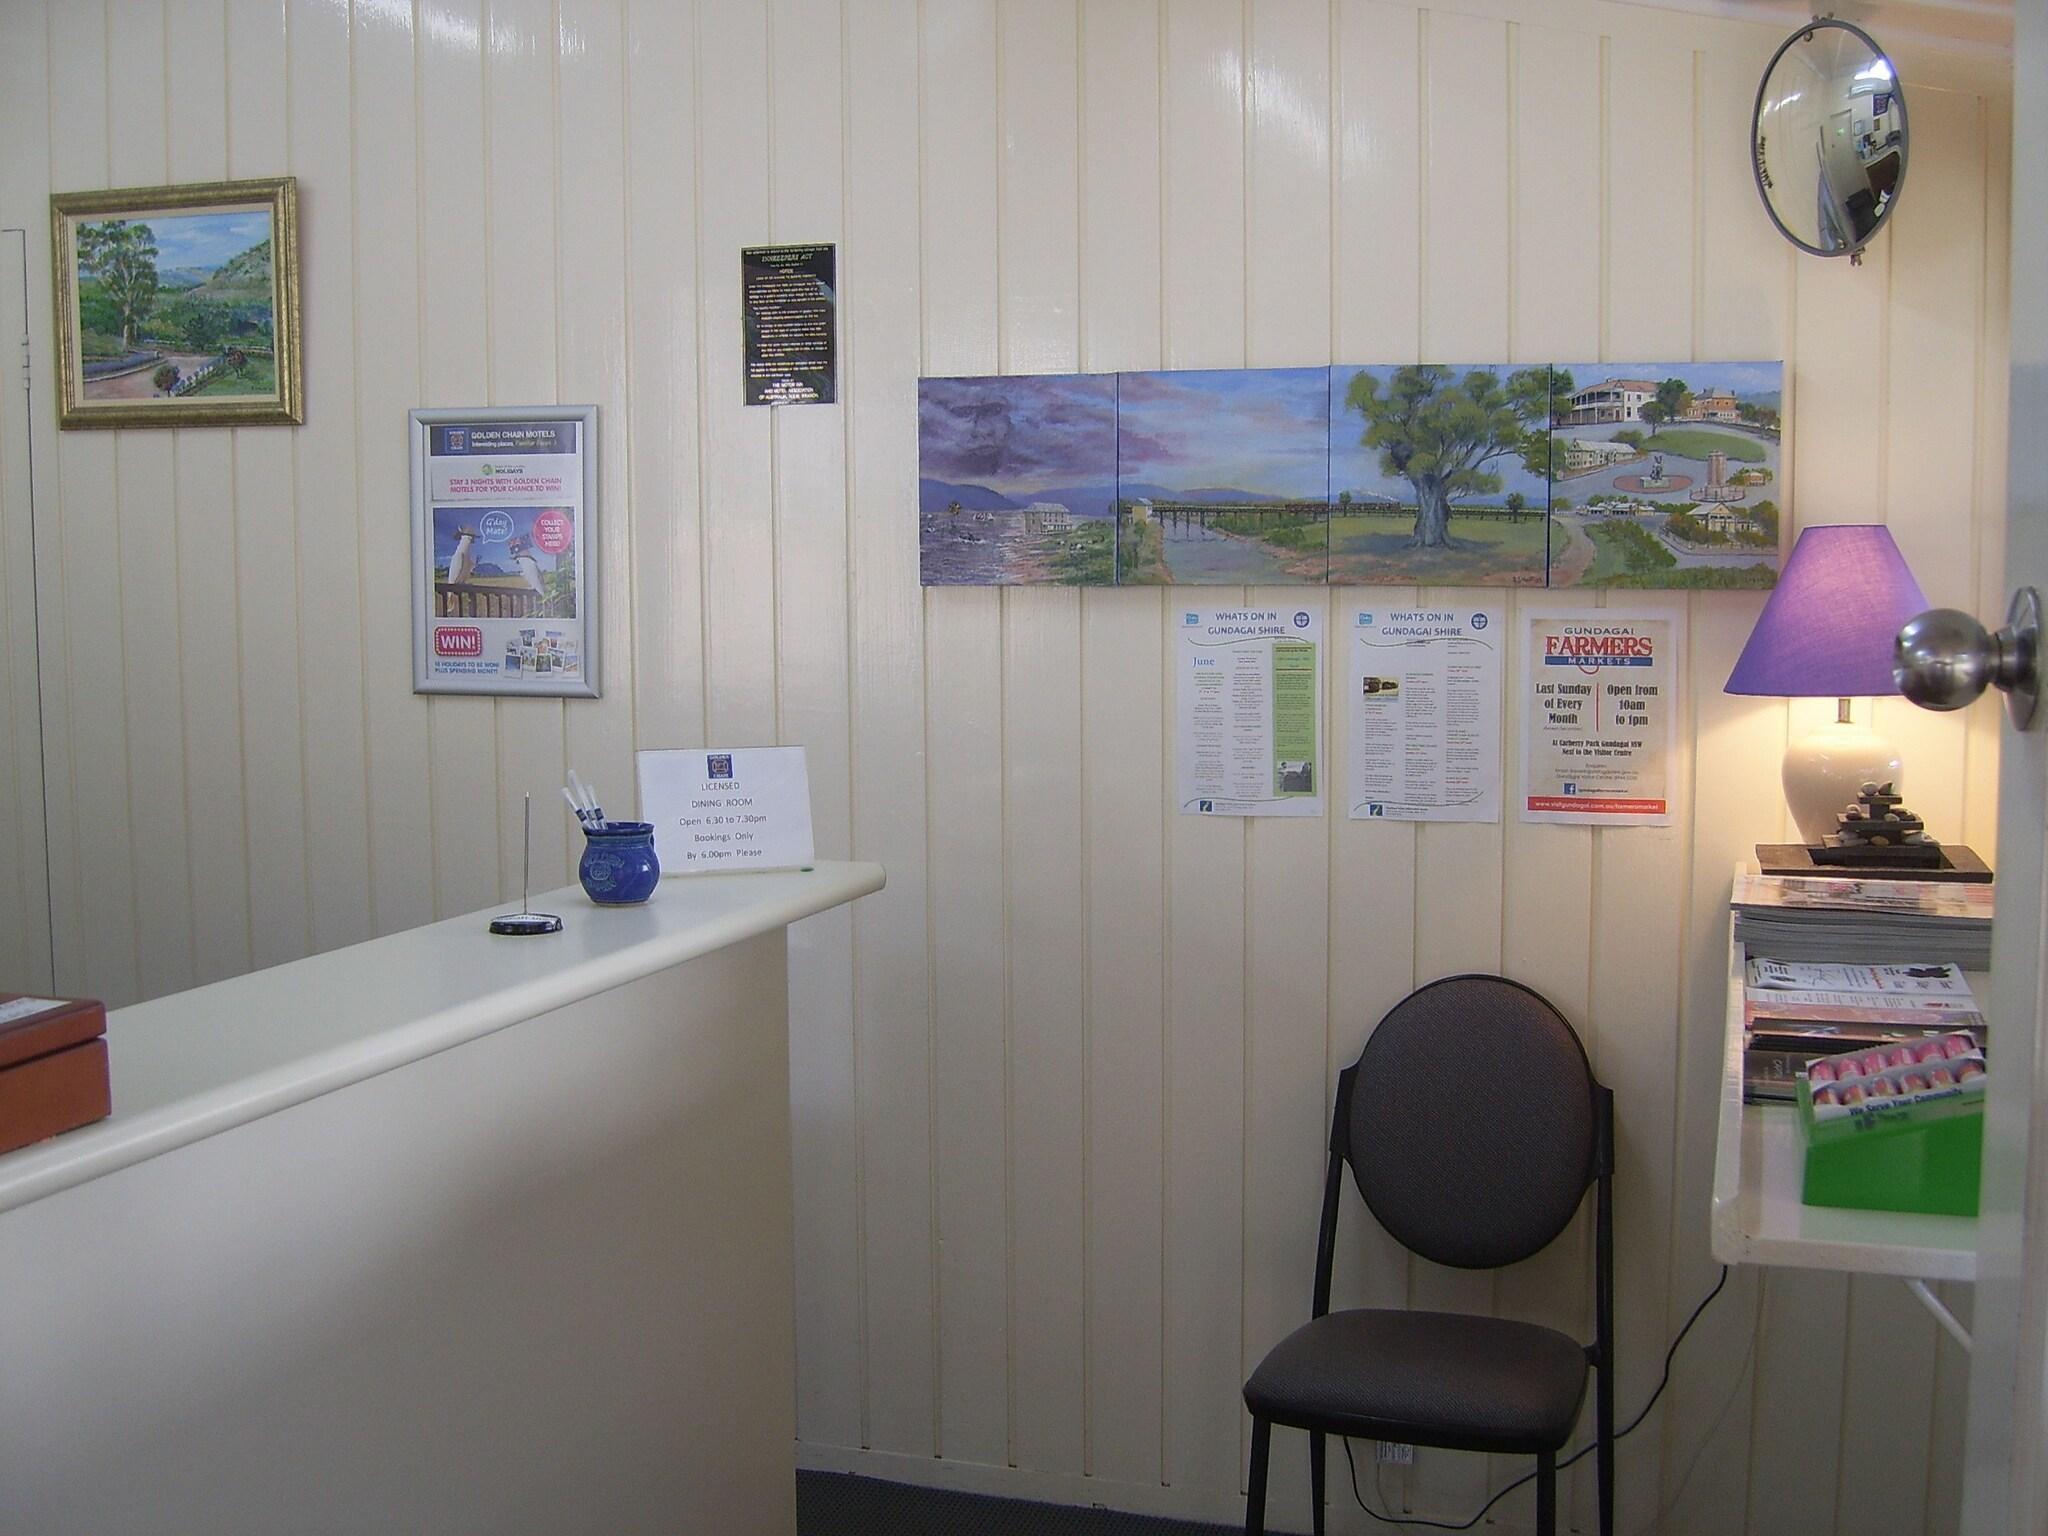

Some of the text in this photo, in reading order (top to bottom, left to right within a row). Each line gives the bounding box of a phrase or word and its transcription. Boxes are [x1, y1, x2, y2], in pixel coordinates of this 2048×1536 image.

[471, 429, 556, 440] GOLDEN CHAIN MOTELS
[1215, 612, 1277, 621] WHATS ON IN
[1390, 612, 1454, 621] WHATS ON IN
[1207, 626, 1256, 635] GUNDAGAI
[1258, 626, 1285, 635] SHIRE
[1381, 627, 1463, 636] GUNDAGAI SHIRE
[1564, 627, 1634, 635] GUNDAGAI
[440, 635, 476, 649] WIN!
[1546, 635, 1653, 657] FARMERS
[1193, 657, 1215, 667] June
[1568, 657, 1631, 665] MARKETS
[1536, 683, 1592, 696] Last Sunday
[1607, 684, 1658, 696] Open from
[1544, 698, 1583, 710] of Every
[1619, 700, 1645, 710] 10am
[1548, 713, 1578, 724] Month
[1615, 714, 1648, 727] to 1pm
[701, 782, 740, 791] LICENSED
[691, 799, 753, 809] DINING ROOM
[679, 815, 767, 827] Open 6.30 to 7.30pm
[694, 832, 754, 843] Bookings Only
[687, 848, 762, 861] By 6.00pm Please
